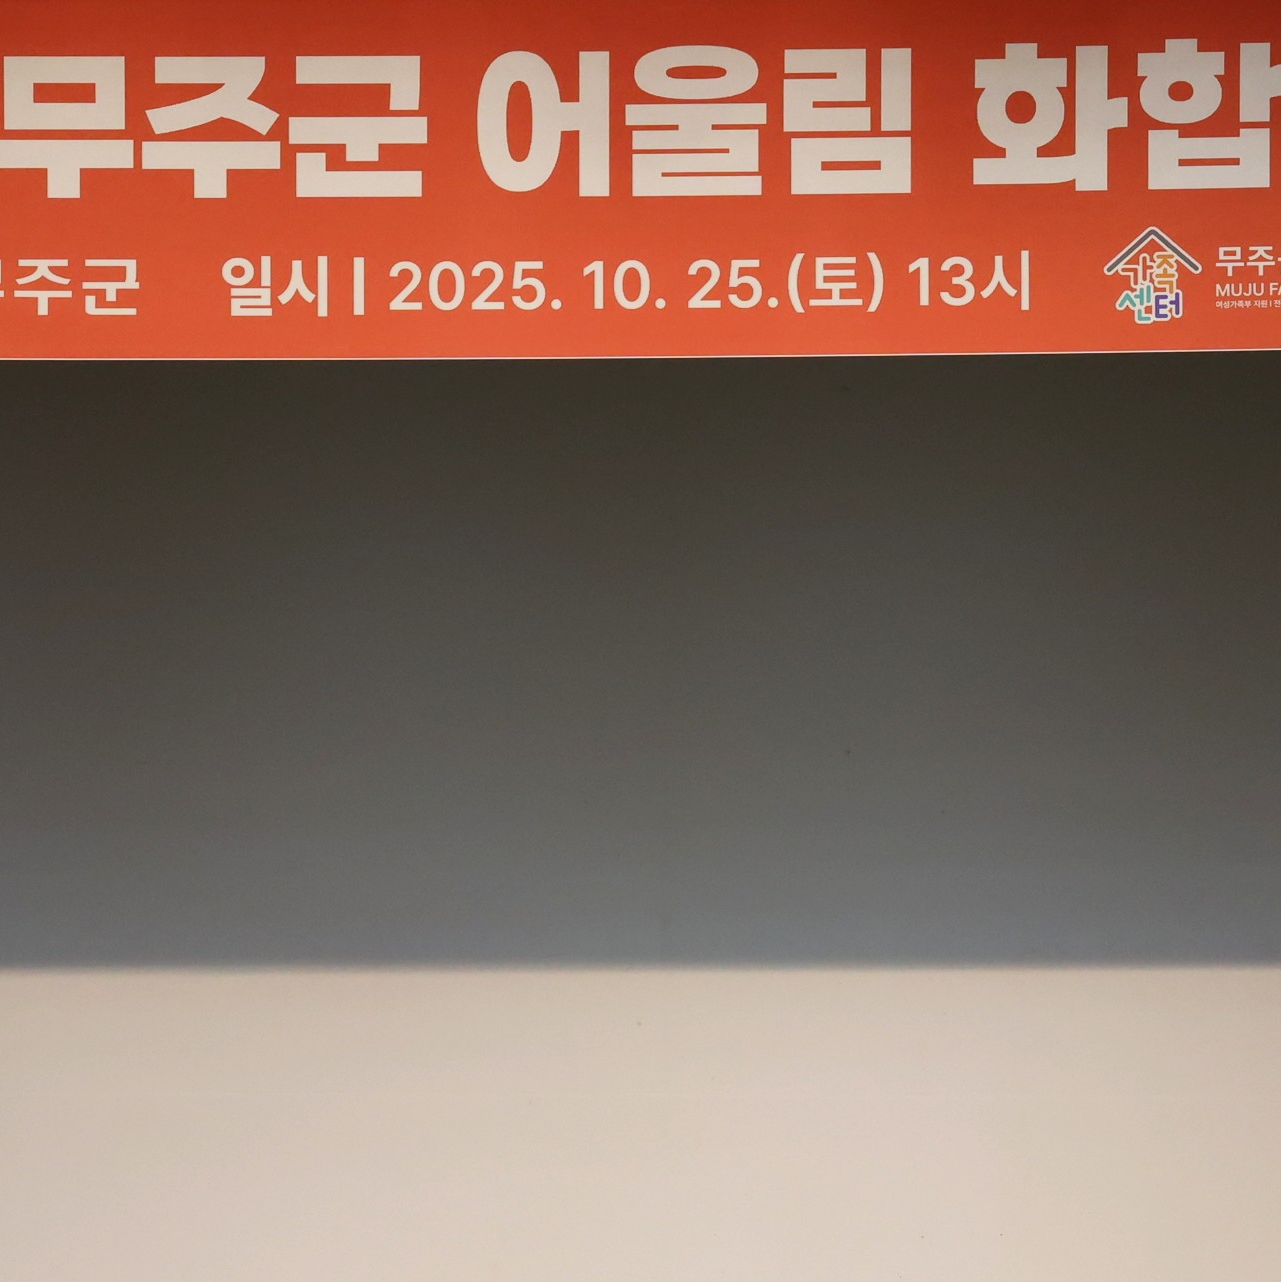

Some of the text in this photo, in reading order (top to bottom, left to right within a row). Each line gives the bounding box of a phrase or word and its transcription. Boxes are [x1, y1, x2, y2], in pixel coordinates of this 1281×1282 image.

[476, 45, 912, 197] 어울림
[389, 260, 562, 311] 2025.
[583, 259, 651, 310] 10.
[687, 252, 884, 314] 25.(토)
[908, 250, 1030, 311] 13시
[1215, 282, 1265, 297] MUJU
